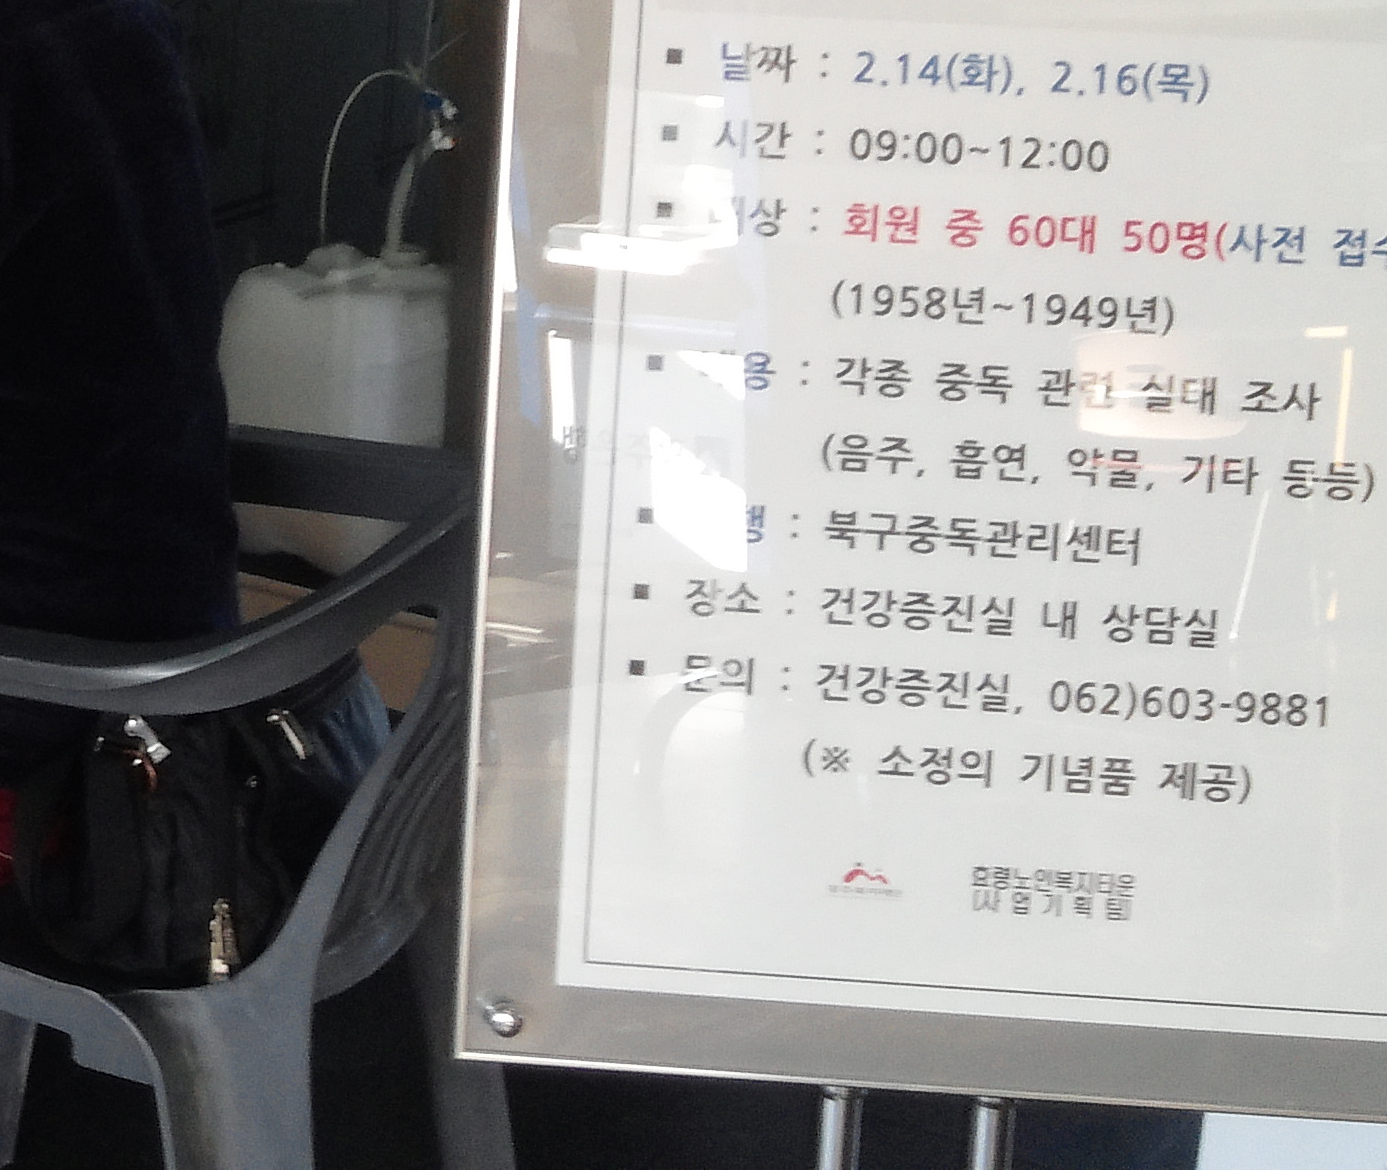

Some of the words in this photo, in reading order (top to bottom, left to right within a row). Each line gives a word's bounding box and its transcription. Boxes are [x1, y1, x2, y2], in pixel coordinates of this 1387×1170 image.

[722, 43, 796, 83] 날짜
[854, 51, 1023, 95] 2.14(화),
[1051, 61, 1208, 104] 2.16(목)
[715, 122, 792, 159] 시간
[850, 129, 1109, 172] 09:00~12:00
[844, 203, 919, 244] 회원
[946, 209, 983, 247] 중
[1008, 215, 1096, 254] 60대
[832, 280, 1174, 336] (1958년~1949년)
[836, 357, 911, 398] 각종
[936, 363, 1013, 404] 중독
[1037, 369, 1113, 408] 관련
[1142, 375, 1217, 415] 실태
[1241, 381, 1321, 421] 조사
[822, 434, 924, 477] (음주,
[950, 440, 1039, 484] 흡연,
[1067, 448, 1153, 491] 약물,
[1182, 455, 1259, 495] 기타
[1282, 460, 1374, 502] 등등)
[824, 511, 1140, 566] 북구중독관리센터
[686, 580, 760, 617] 장소
[822, 588, 1014, 636] 건강증진실
[1042, 601, 1077, 639] 내
[1103, 605, 1218, 648] 상담실
[684, 655, 754, 695] 문의
[817, 665, 1022, 714] 건강증진실,
[1050, 681, 1328, 727] 062)603-9881
[878, 746, 992, 788] 소정의
[1020, 754, 1136, 796] 기념품
[1159, 763, 1251, 804] 제공)
[972, 865, 1135, 897] 효령노인복지타운
